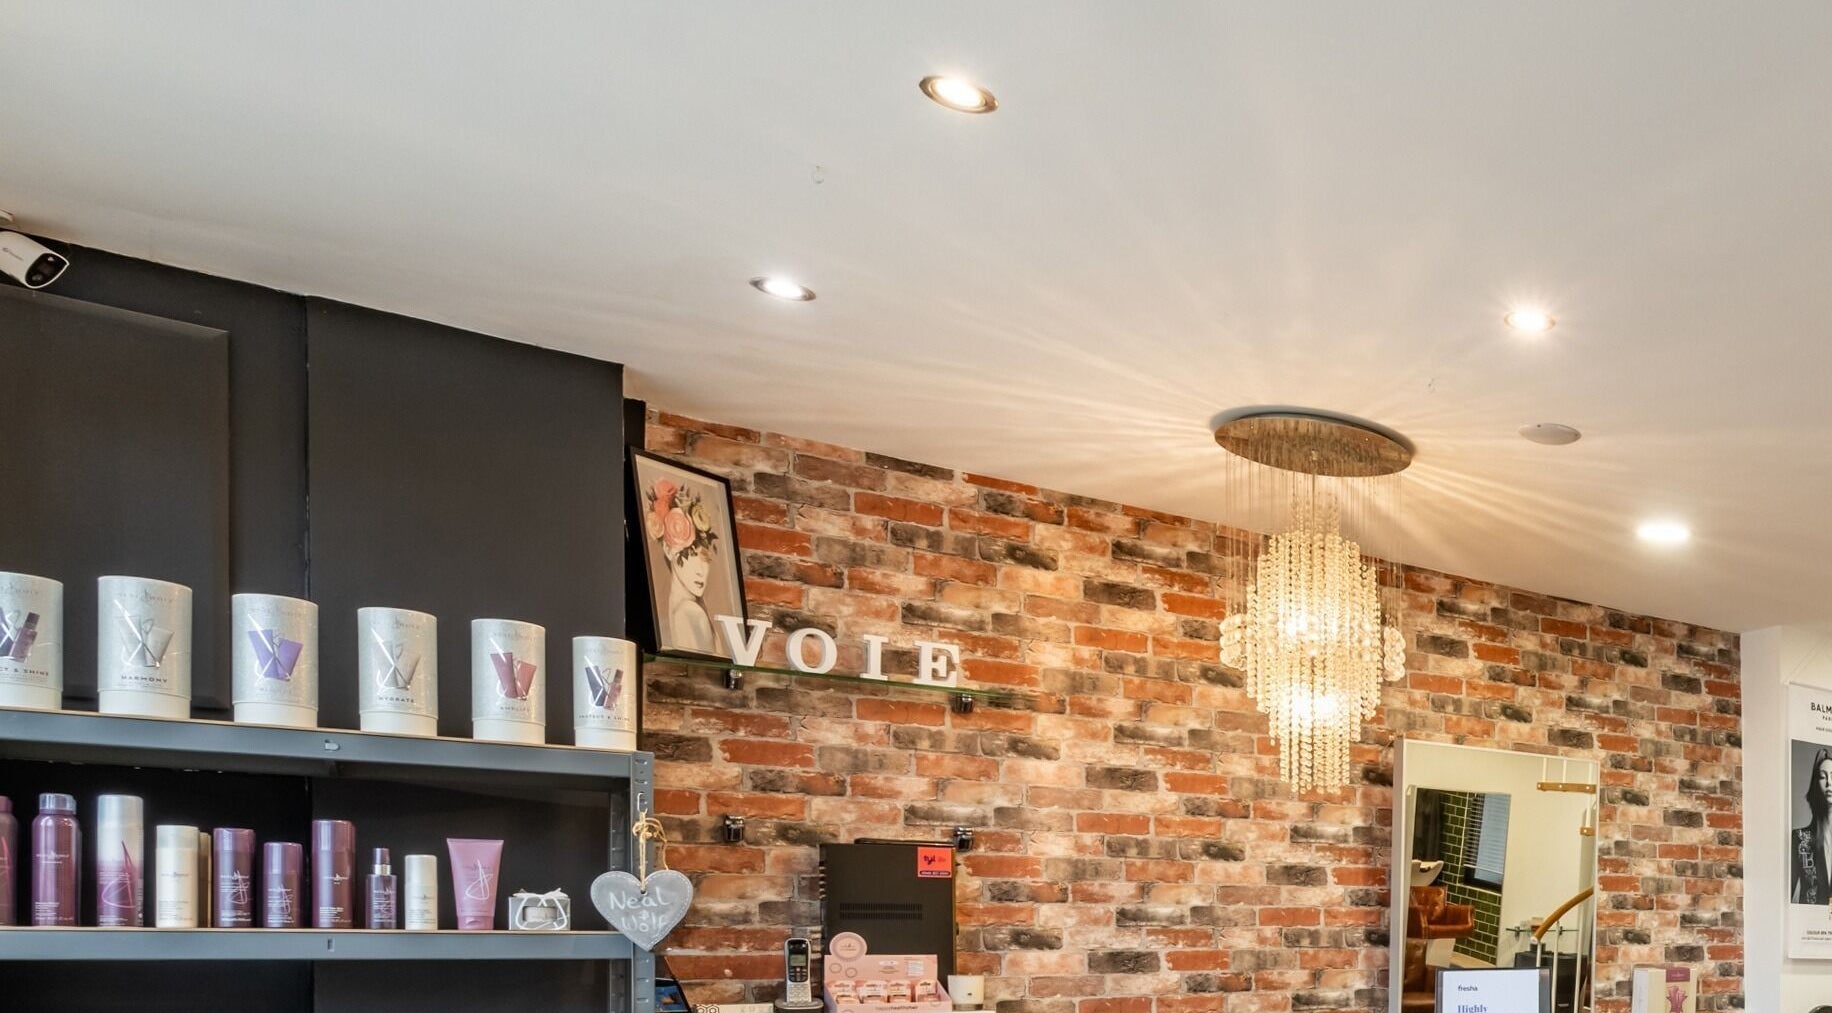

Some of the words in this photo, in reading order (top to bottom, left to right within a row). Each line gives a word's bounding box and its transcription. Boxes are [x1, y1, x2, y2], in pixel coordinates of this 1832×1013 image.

[714, 613, 961, 688] VOIE
[121, 675, 168, 683] HARMONY
[608, 886, 672, 910] Neal
[621, 912, 668, 933] Wolf
[1458, 984, 1478, 992] fresha
